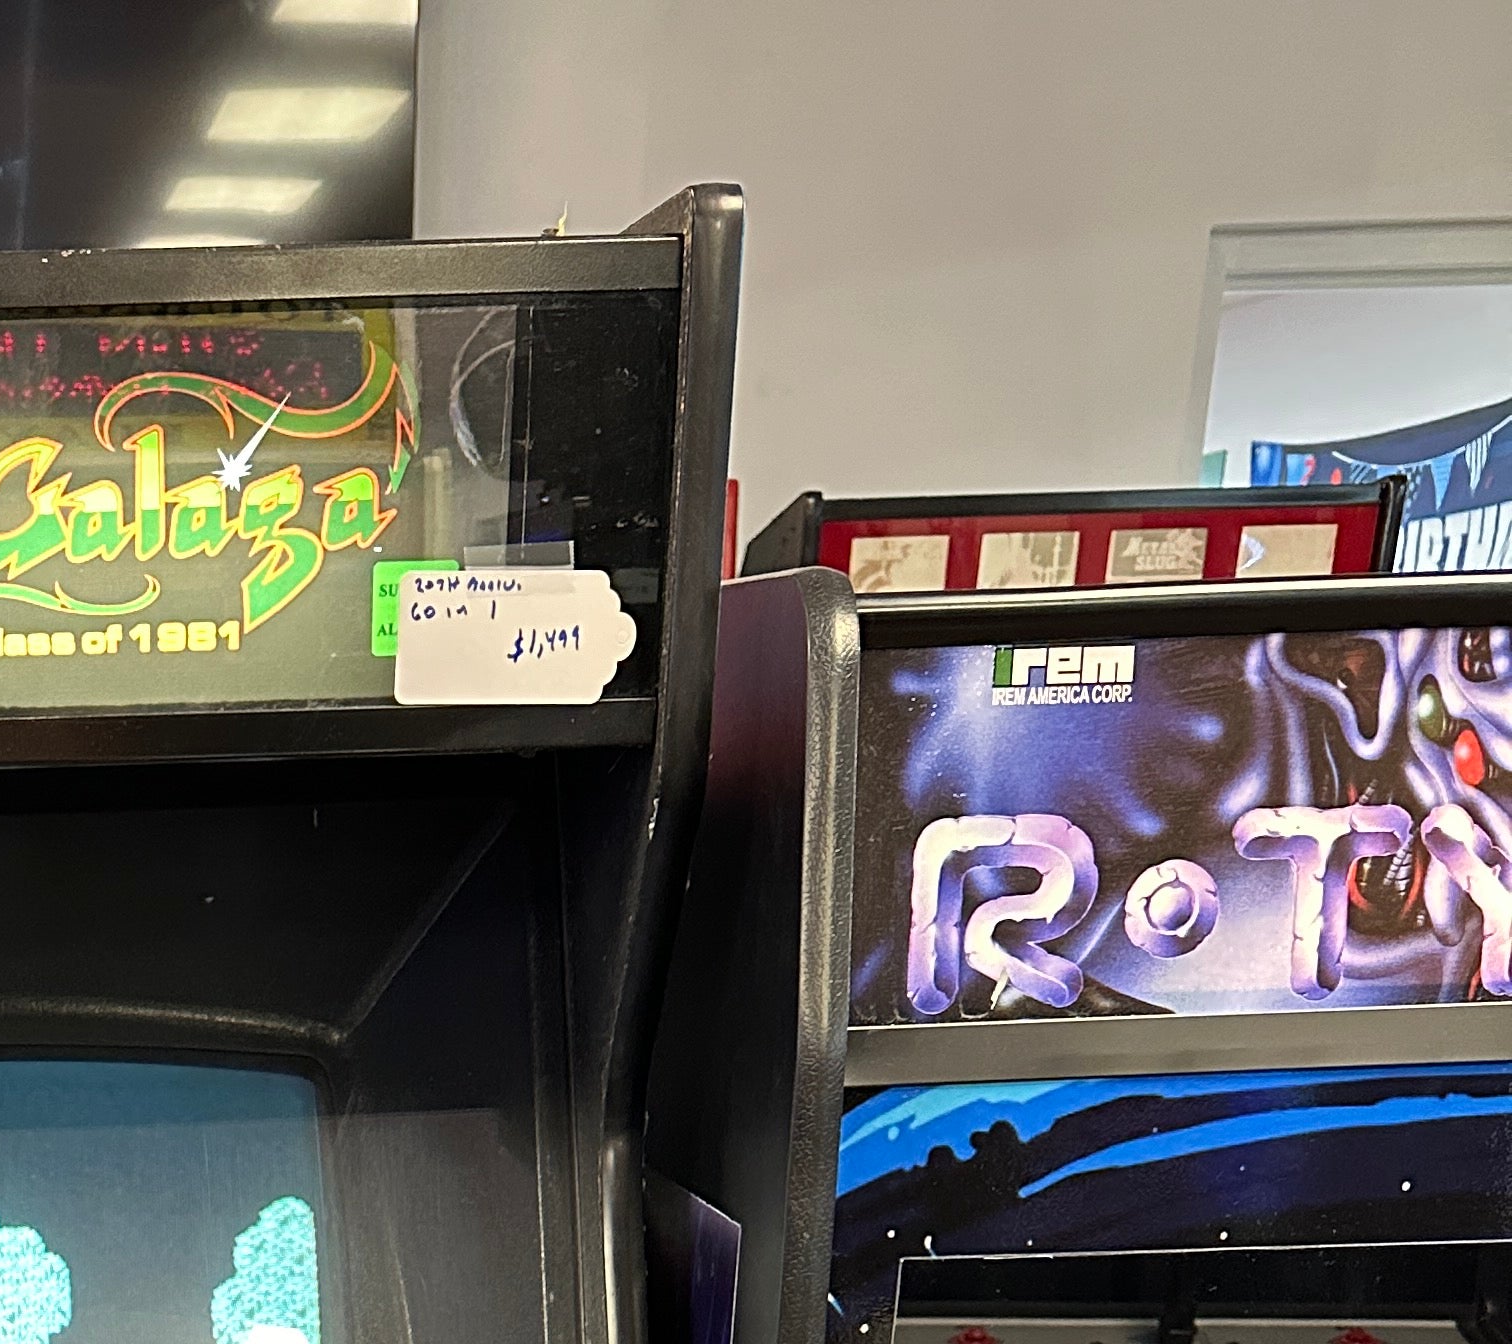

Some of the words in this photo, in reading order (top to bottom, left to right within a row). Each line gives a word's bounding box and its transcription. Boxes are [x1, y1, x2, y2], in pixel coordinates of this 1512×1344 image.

[411, 602, 436, 621] 60
[490, 599, 496, 620] 1
[81, 623, 124, 658] of
[128, 620, 242, 653] 1981
[507, 625, 580, 663] $1,499
[991, 686, 1027, 706] IREM
[1026, 685, 1090, 705] AMERICA
[1091, 684, 1133, 704] CORP.
